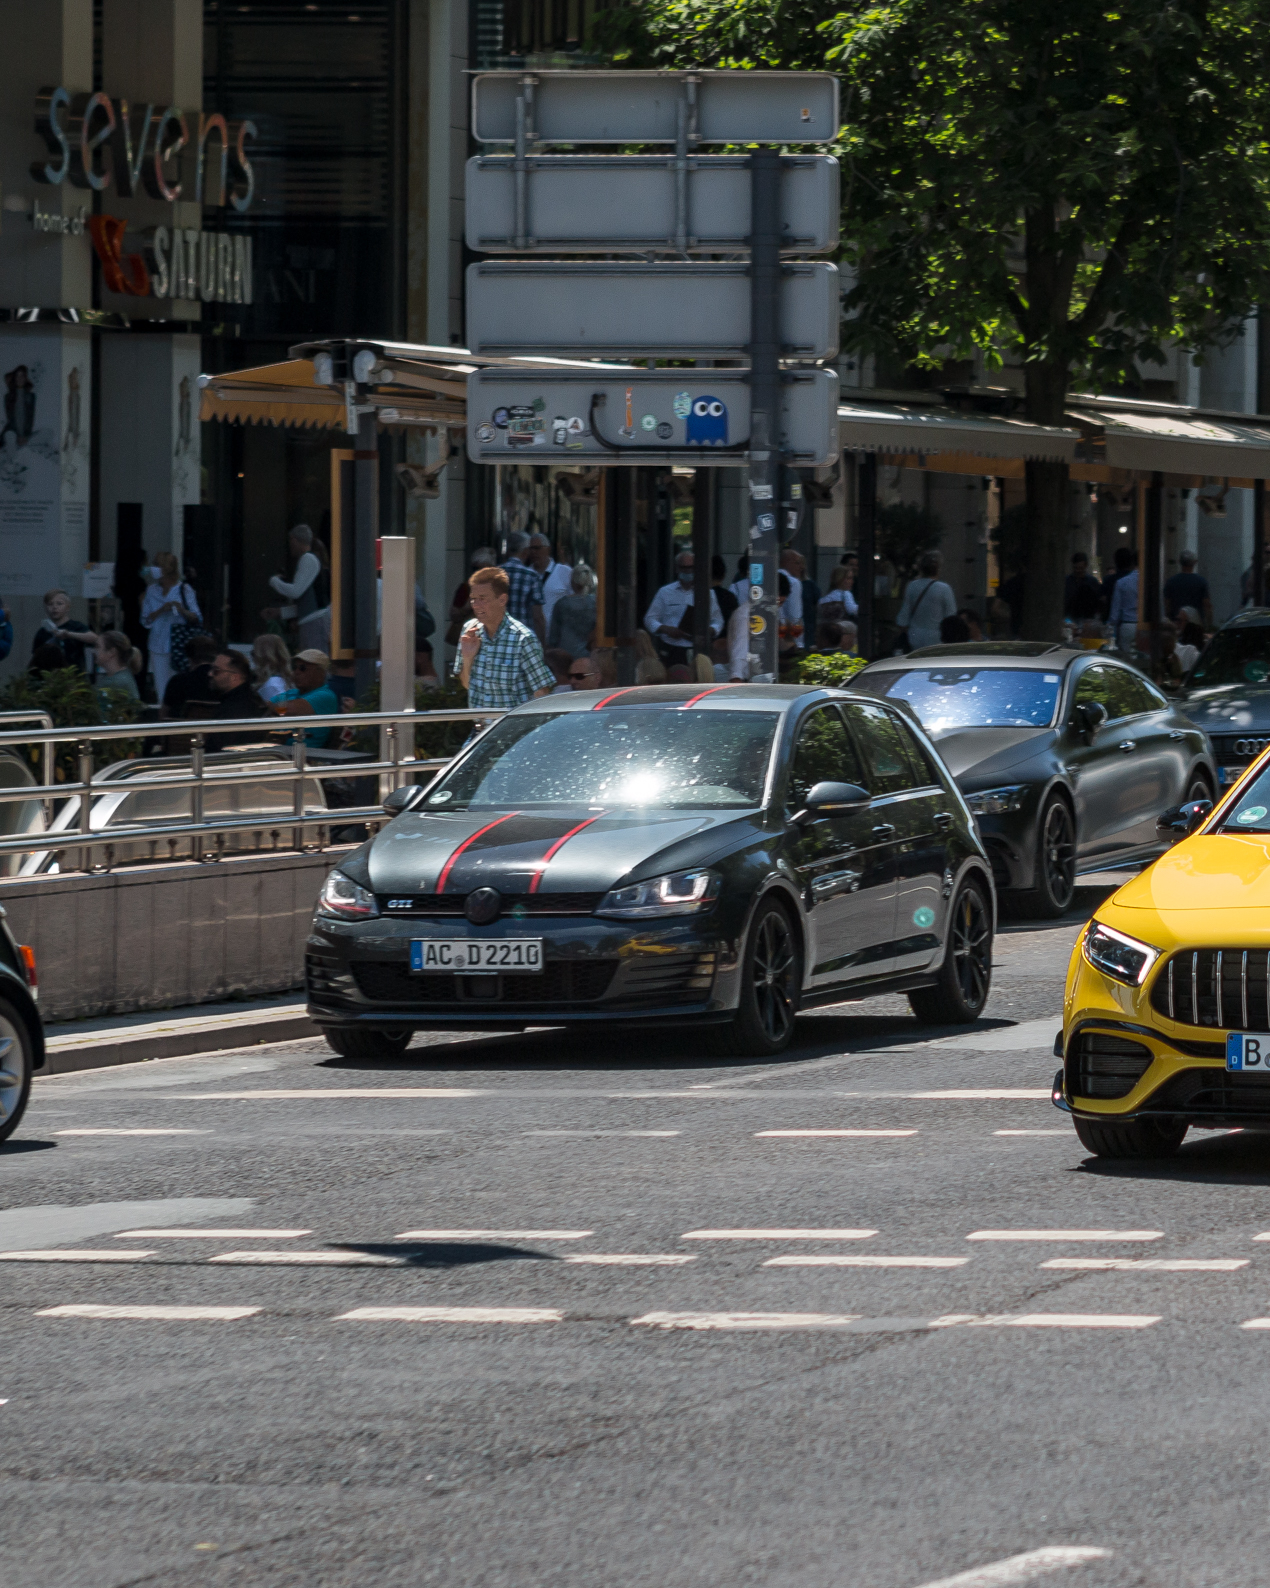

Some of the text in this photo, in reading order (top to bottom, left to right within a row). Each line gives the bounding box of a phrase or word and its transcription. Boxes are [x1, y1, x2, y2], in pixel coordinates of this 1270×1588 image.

[38, 86, 258, 213] sevens
[34, 199, 86, 236] home of
[151, 226, 254, 305] SATURN
[387, 899, 413, 908] GTI
[425, 944, 539, 966] AC D 2210
[1244, 1038, 1261, 1066] B
